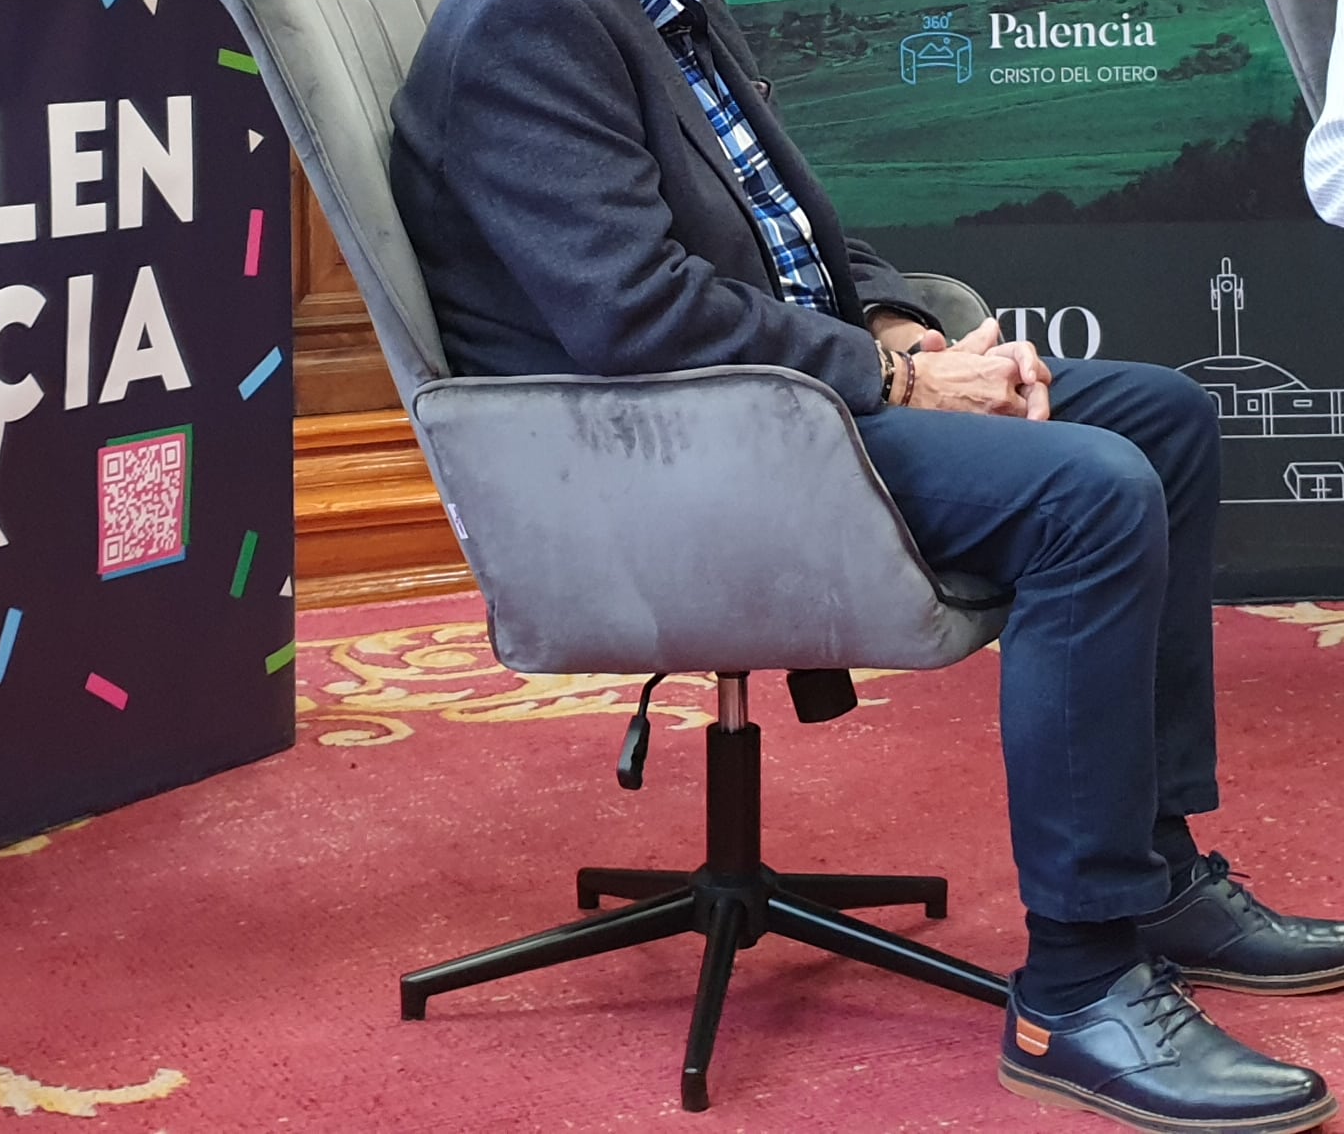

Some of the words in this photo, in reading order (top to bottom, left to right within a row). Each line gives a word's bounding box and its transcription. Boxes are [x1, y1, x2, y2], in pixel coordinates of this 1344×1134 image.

[988, 10, 1157, 49] Palencia
[989, 67, 1056, 84] CRISTO
[1060, 67, 1092, 83] DEL
[1097, 66, 1158, 82] OTERO
